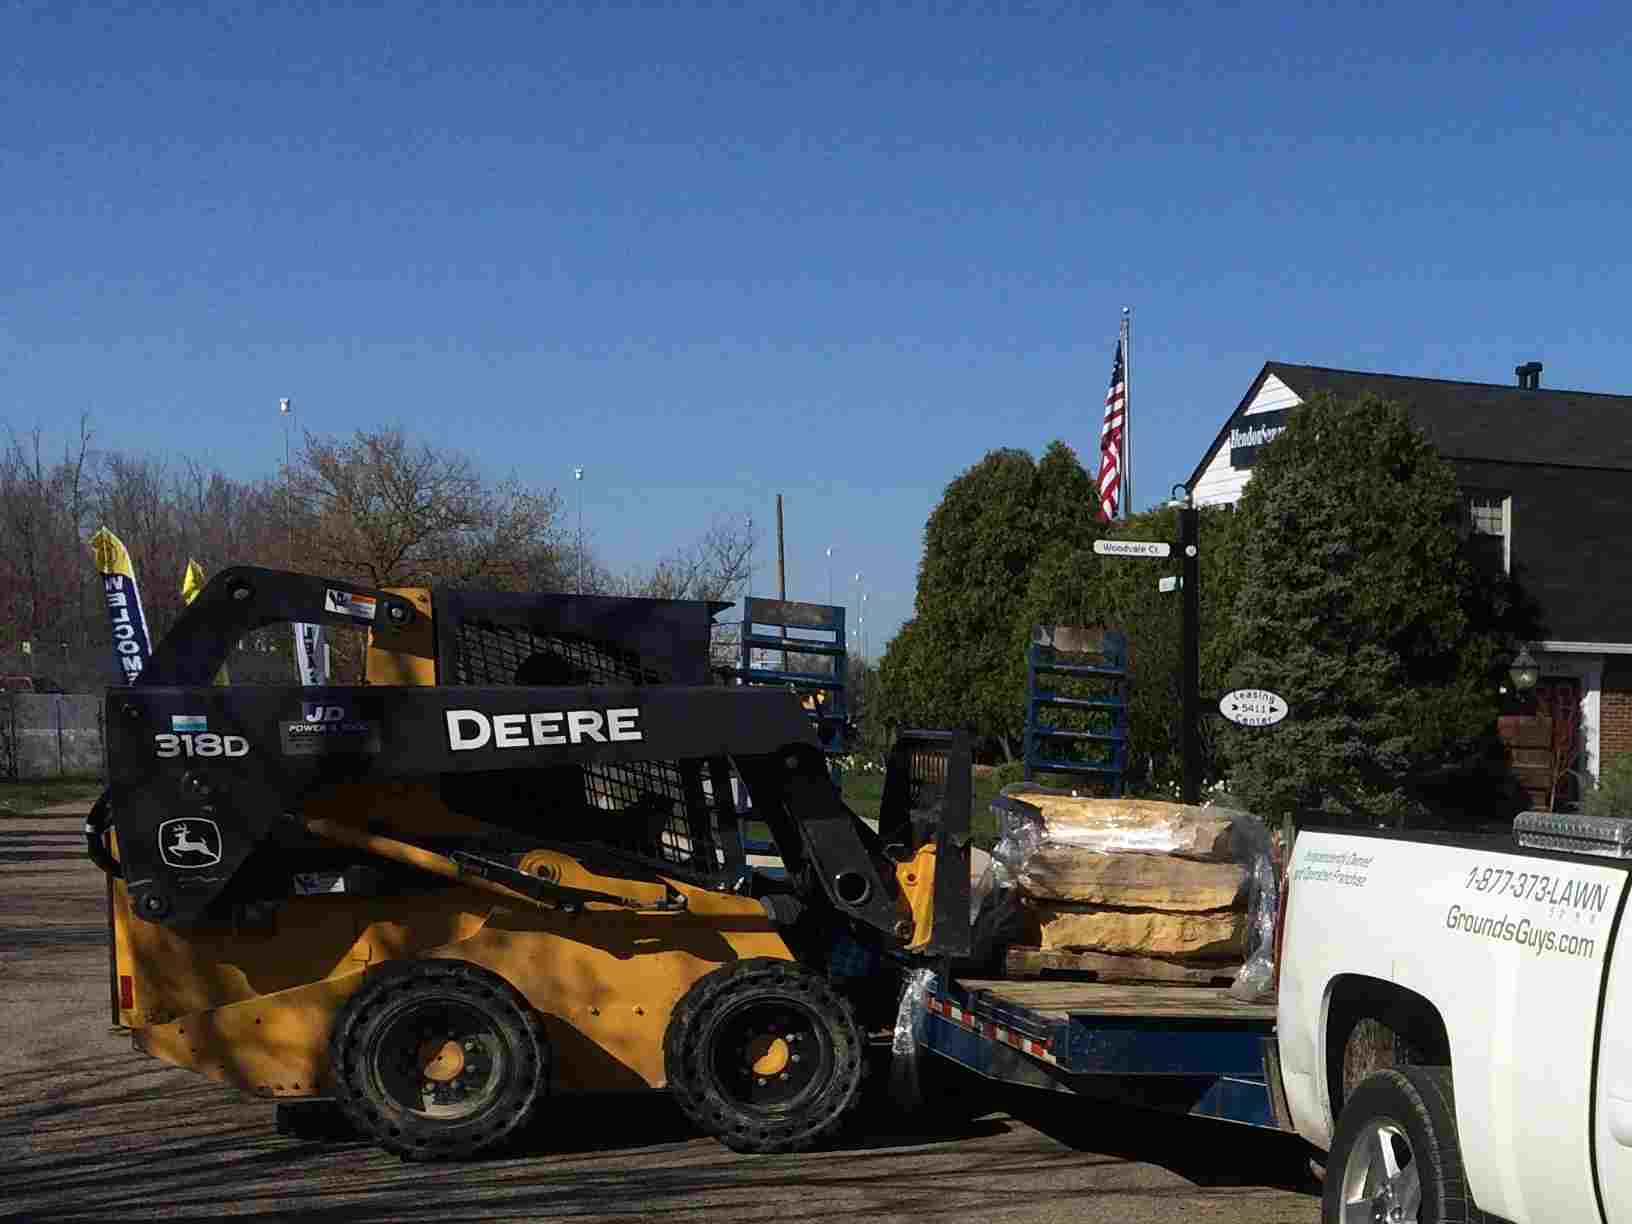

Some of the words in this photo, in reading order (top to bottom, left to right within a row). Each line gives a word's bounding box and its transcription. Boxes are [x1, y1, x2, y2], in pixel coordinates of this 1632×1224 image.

[1232, 690, 1275, 705] Leasing
[306, 706, 345, 722] JD
[1242, 704, 1266, 714] 5411
[1235, 713, 1273, 726] Center
[446, 707, 643, 751] DEERE
[154, 733, 250, 758] 318D
[1446, 904, 1595, 959] GroundsGuys.com
